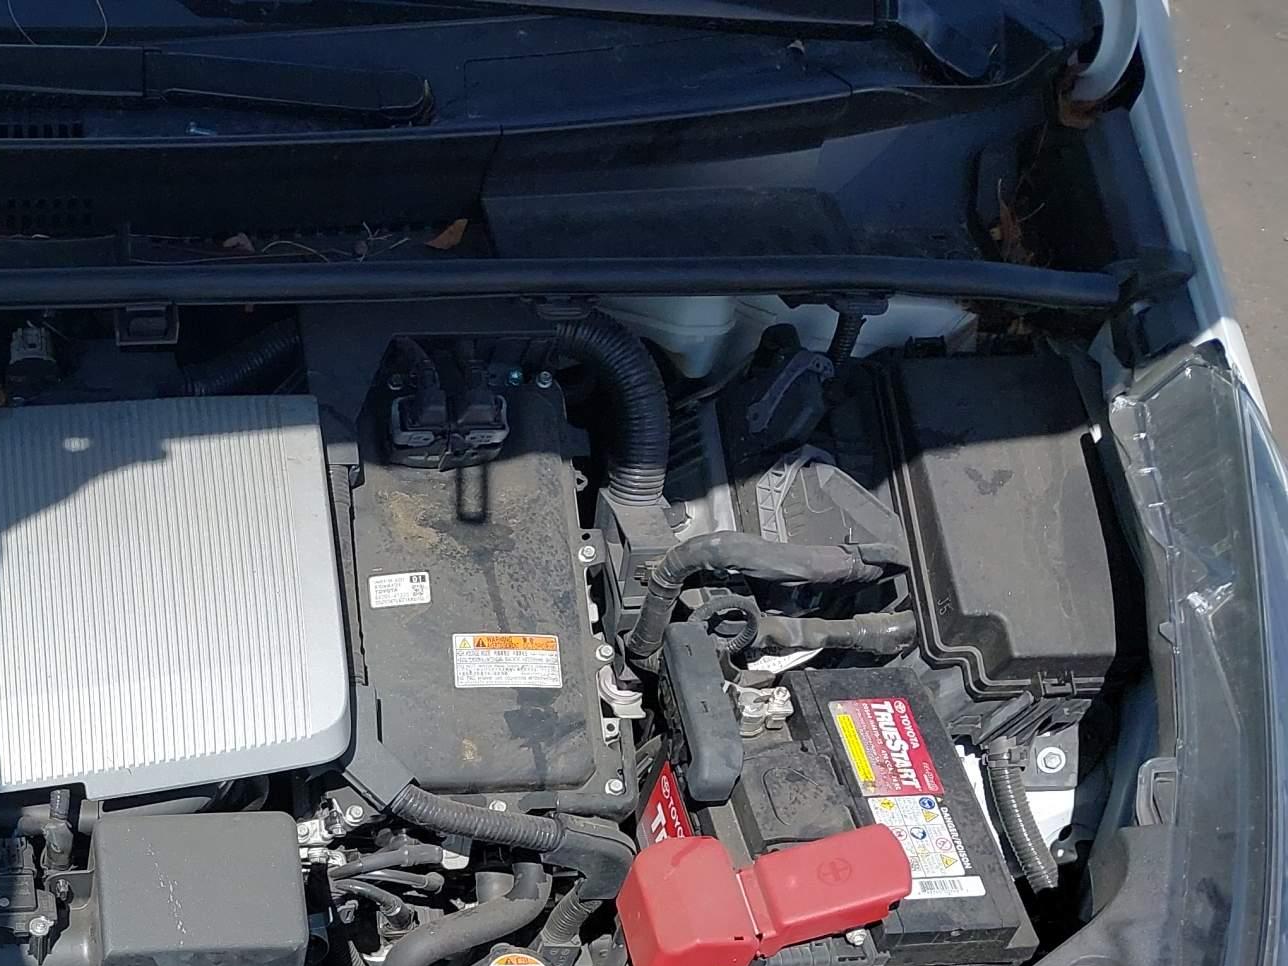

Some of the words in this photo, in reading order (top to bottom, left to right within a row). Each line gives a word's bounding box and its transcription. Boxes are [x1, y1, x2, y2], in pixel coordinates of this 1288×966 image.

[899, 713, 921, 750] TOYOTA
[666, 796, 686, 838] TOYO
[940, 807, 973, 870] DANGER/POISON
